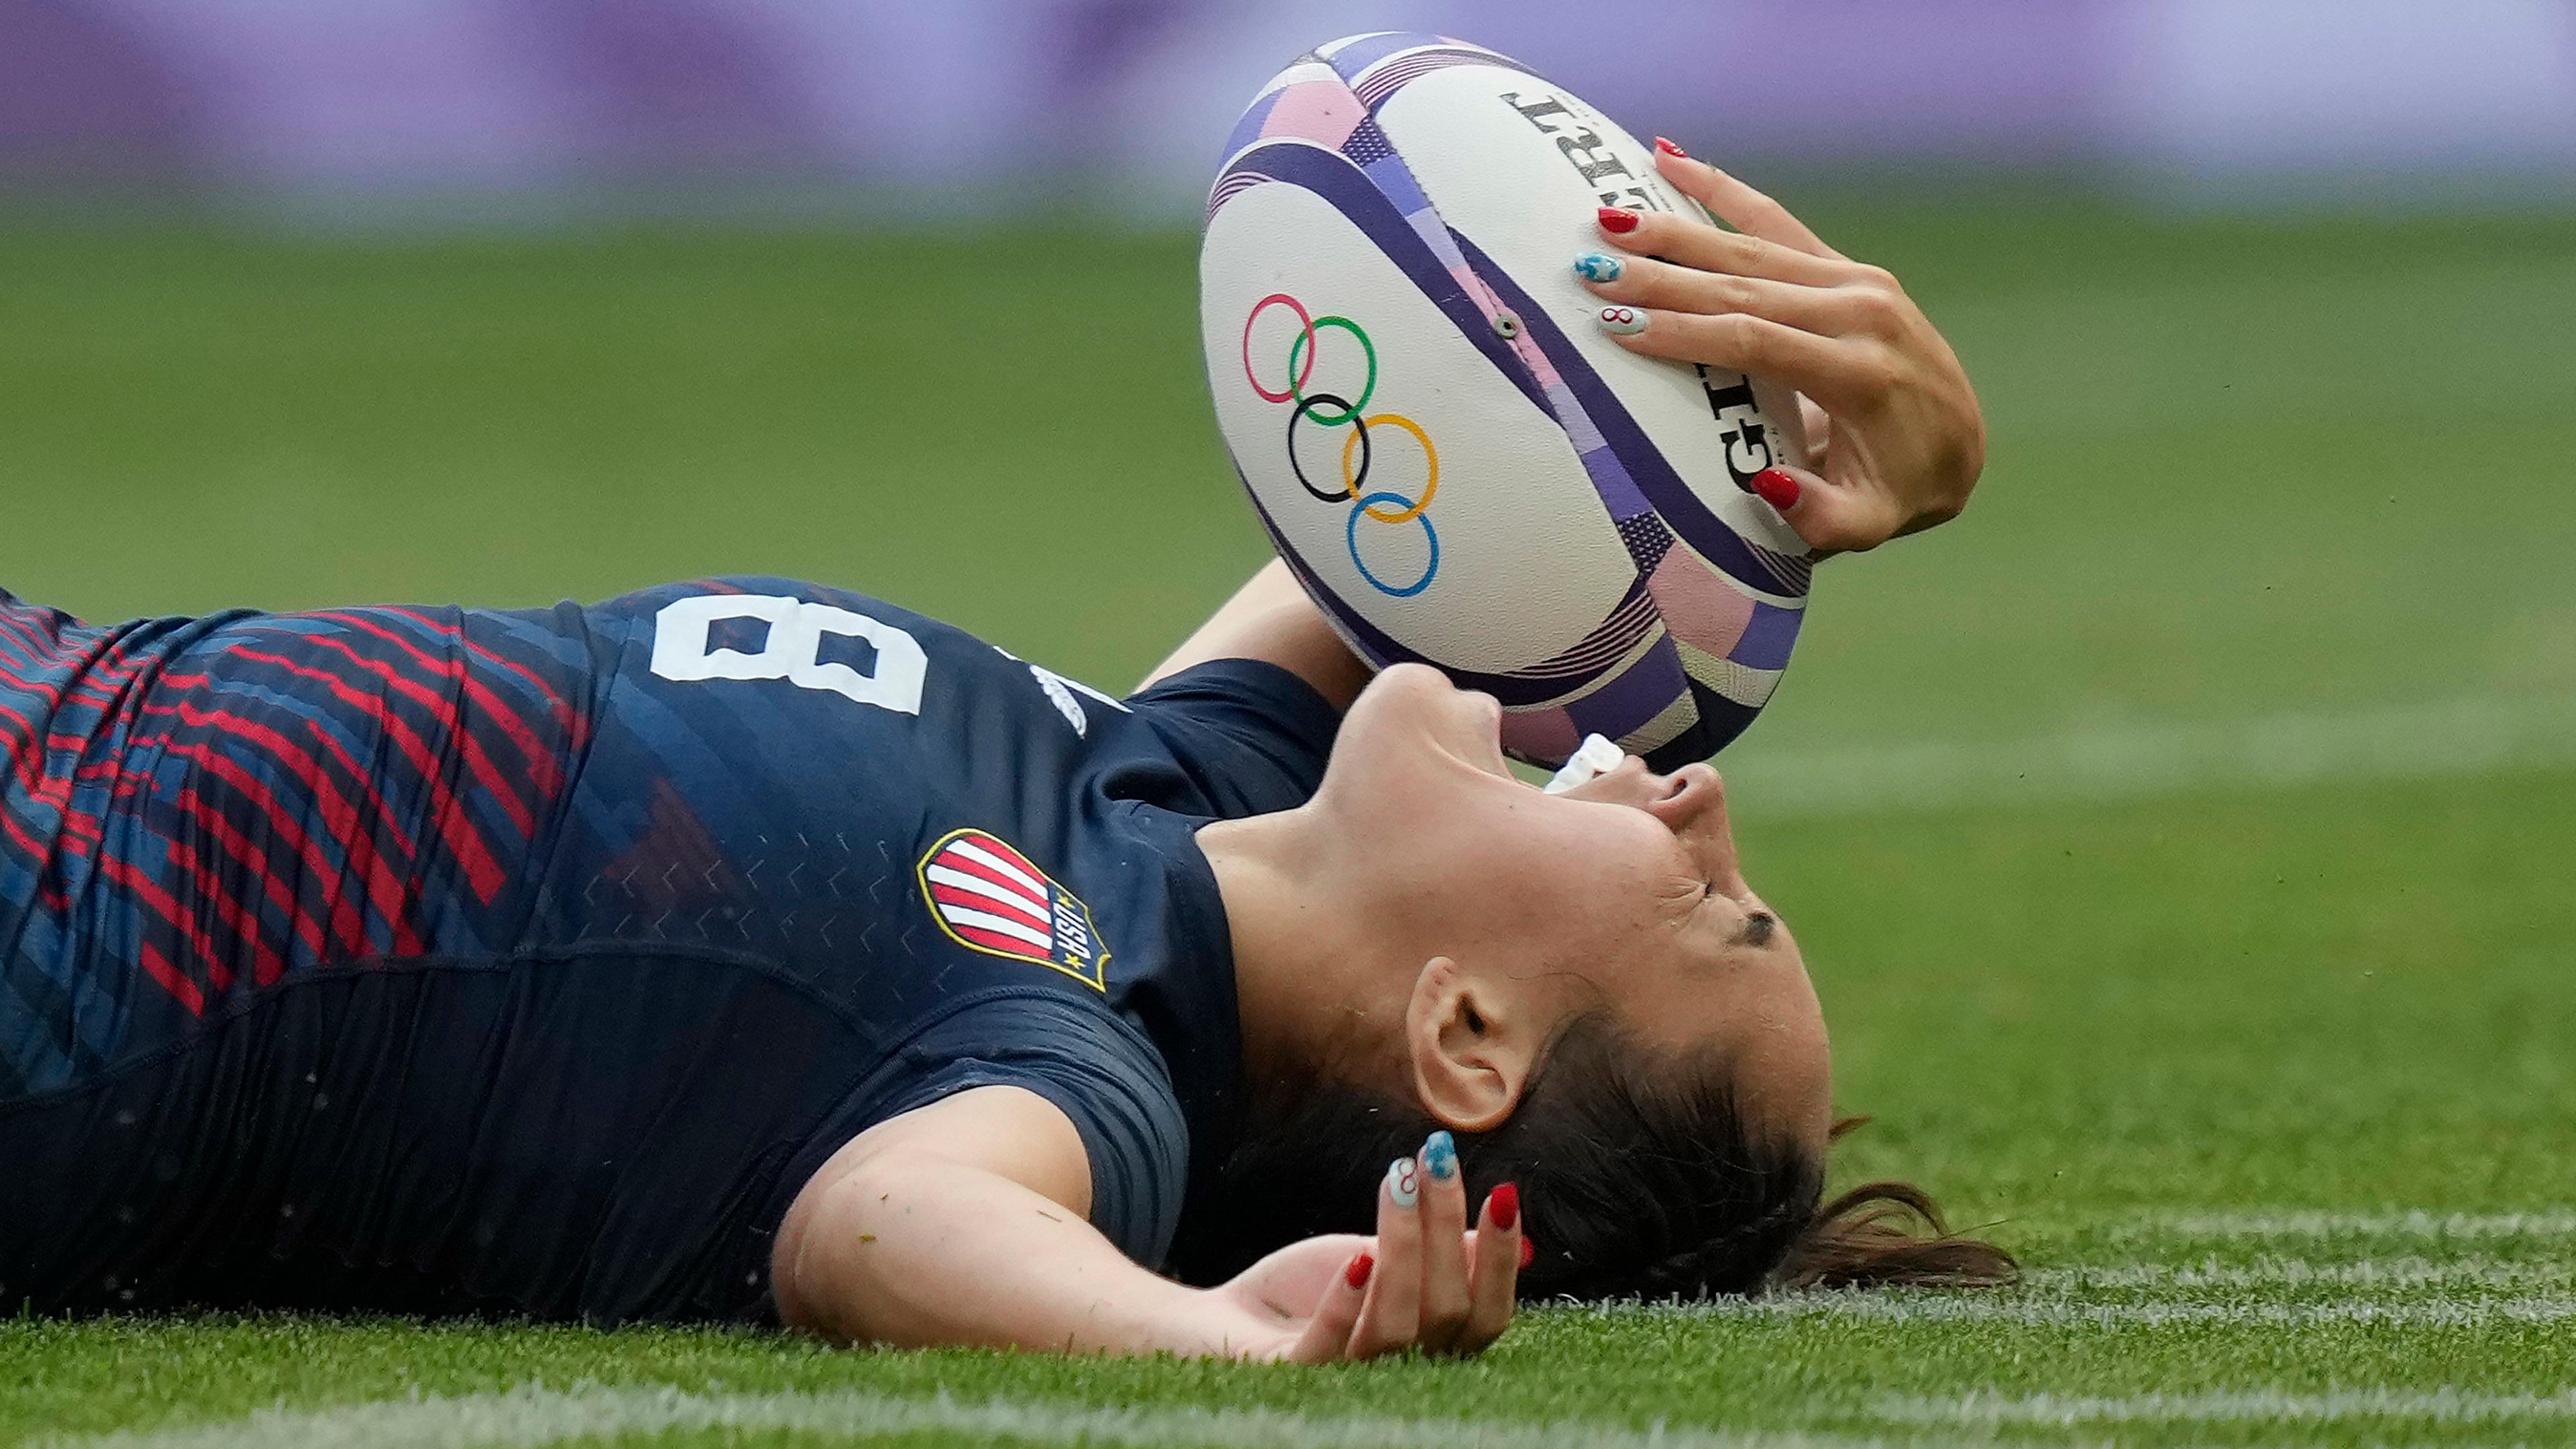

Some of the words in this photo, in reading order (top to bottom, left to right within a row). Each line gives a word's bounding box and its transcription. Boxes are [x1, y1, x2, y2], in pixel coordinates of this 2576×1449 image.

[1499, 91, 1774, 495] GIRT
[1601, 307, 1633, 324] 8
[650, 594, 928, 716] 8
[1053, 902, 1092, 959] USA
